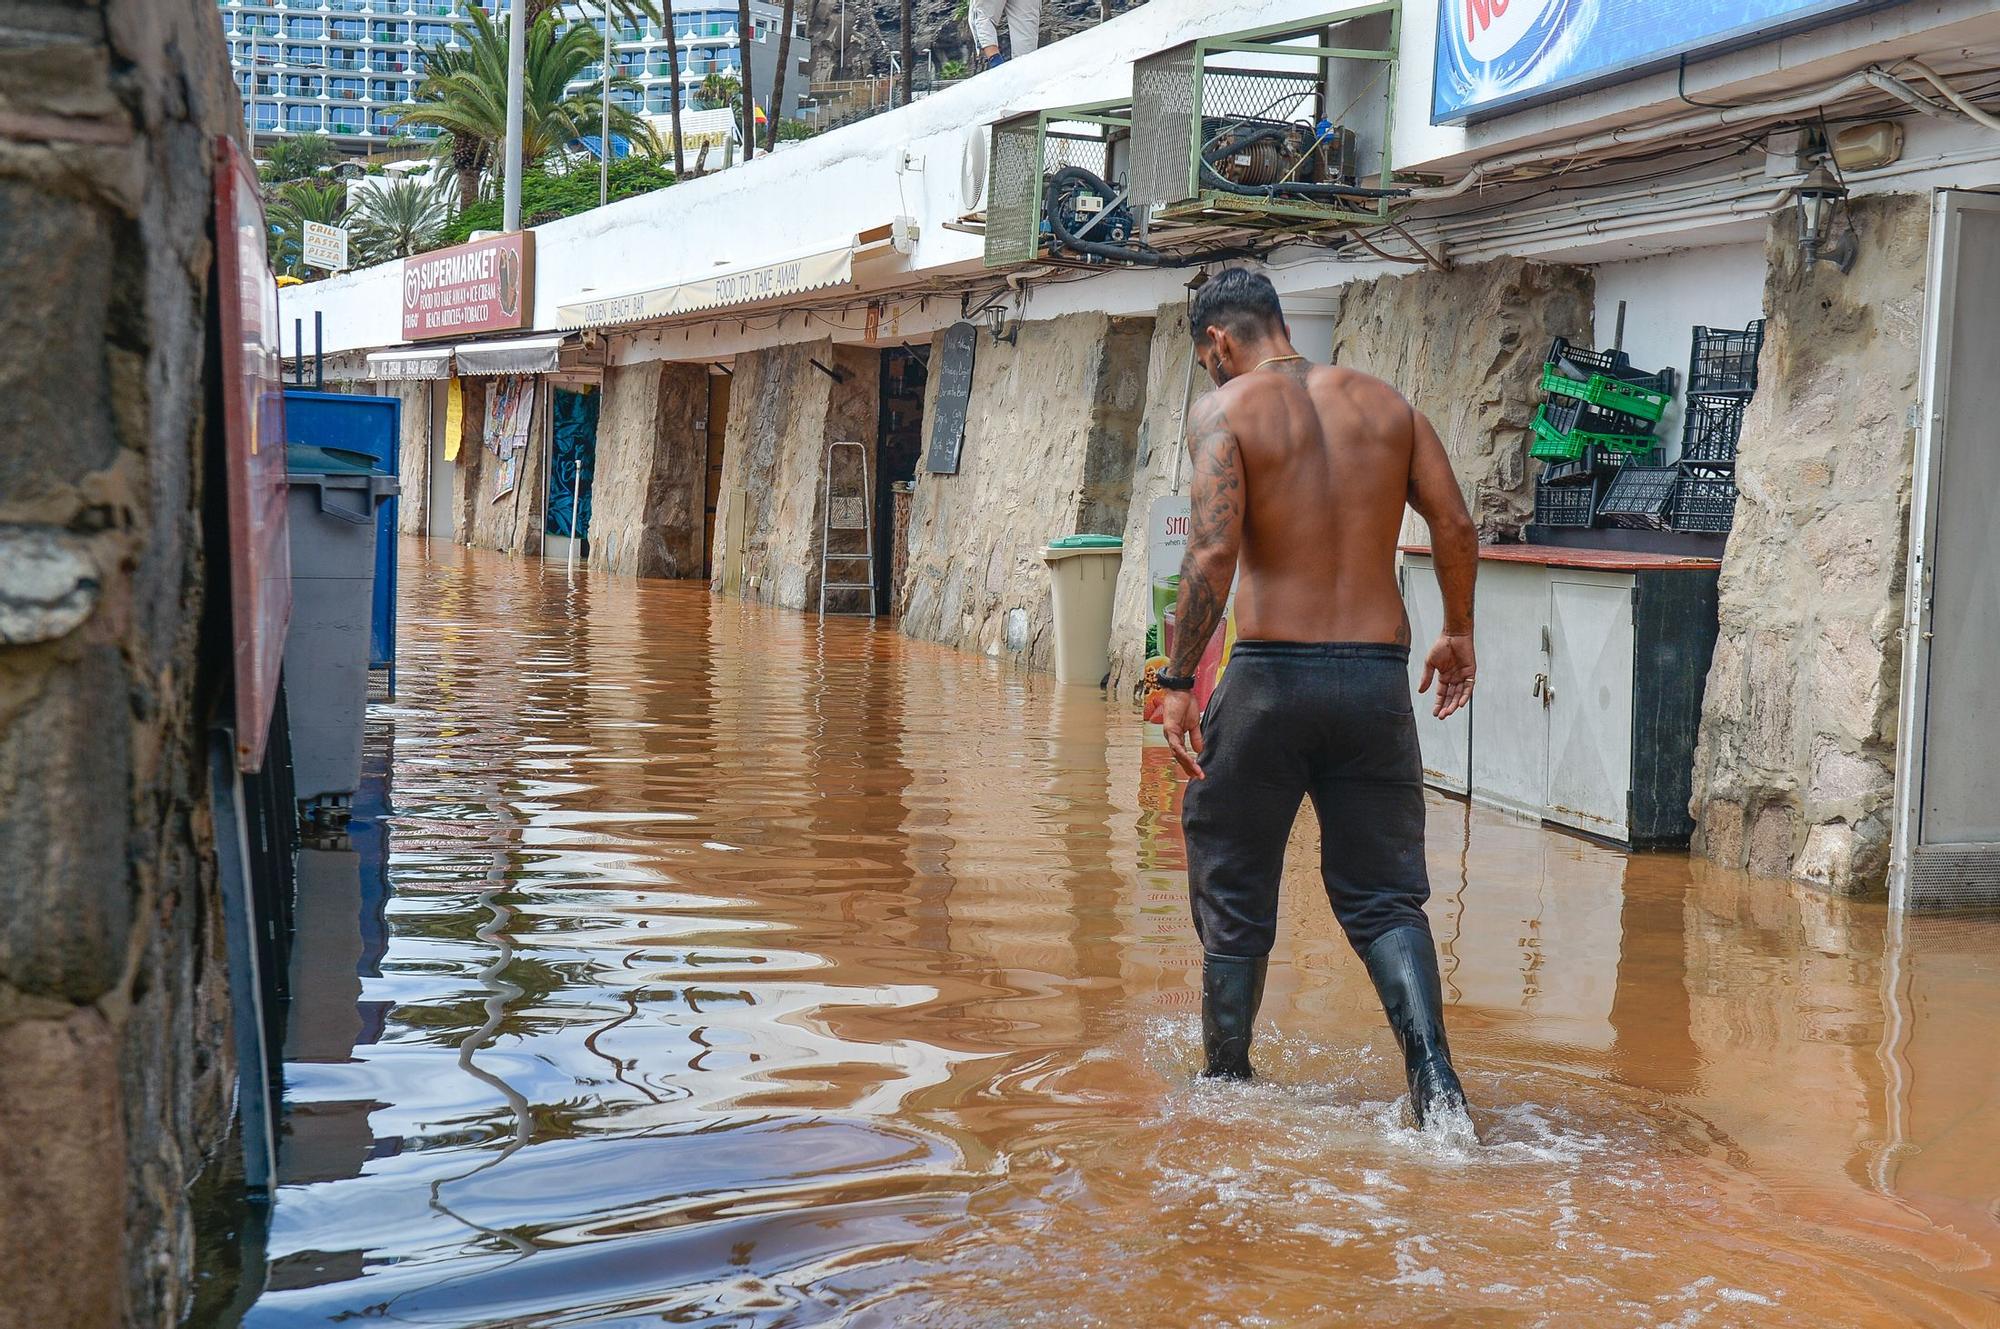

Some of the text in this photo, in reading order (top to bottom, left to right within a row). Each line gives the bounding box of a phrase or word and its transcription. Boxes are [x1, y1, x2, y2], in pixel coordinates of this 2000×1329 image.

[308, 235, 340, 249] PASTA
[309, 224, 337, 237] GRILL
[308, 247, 339, 260] PIZZA
[420, 247, 497, 290] SUPERMARKET
[715, 263, 800, 300] FOOD TO TAKE AWAY
[420, 282, 496, 310] FOOD TO TAKE AWAY ICE CREAM
[585, 295, 645, 322] GOLDEN BEACH BAR
[425, 309, 441, 328] BEACH
[464, 304, 489, 323] TOBACCO
